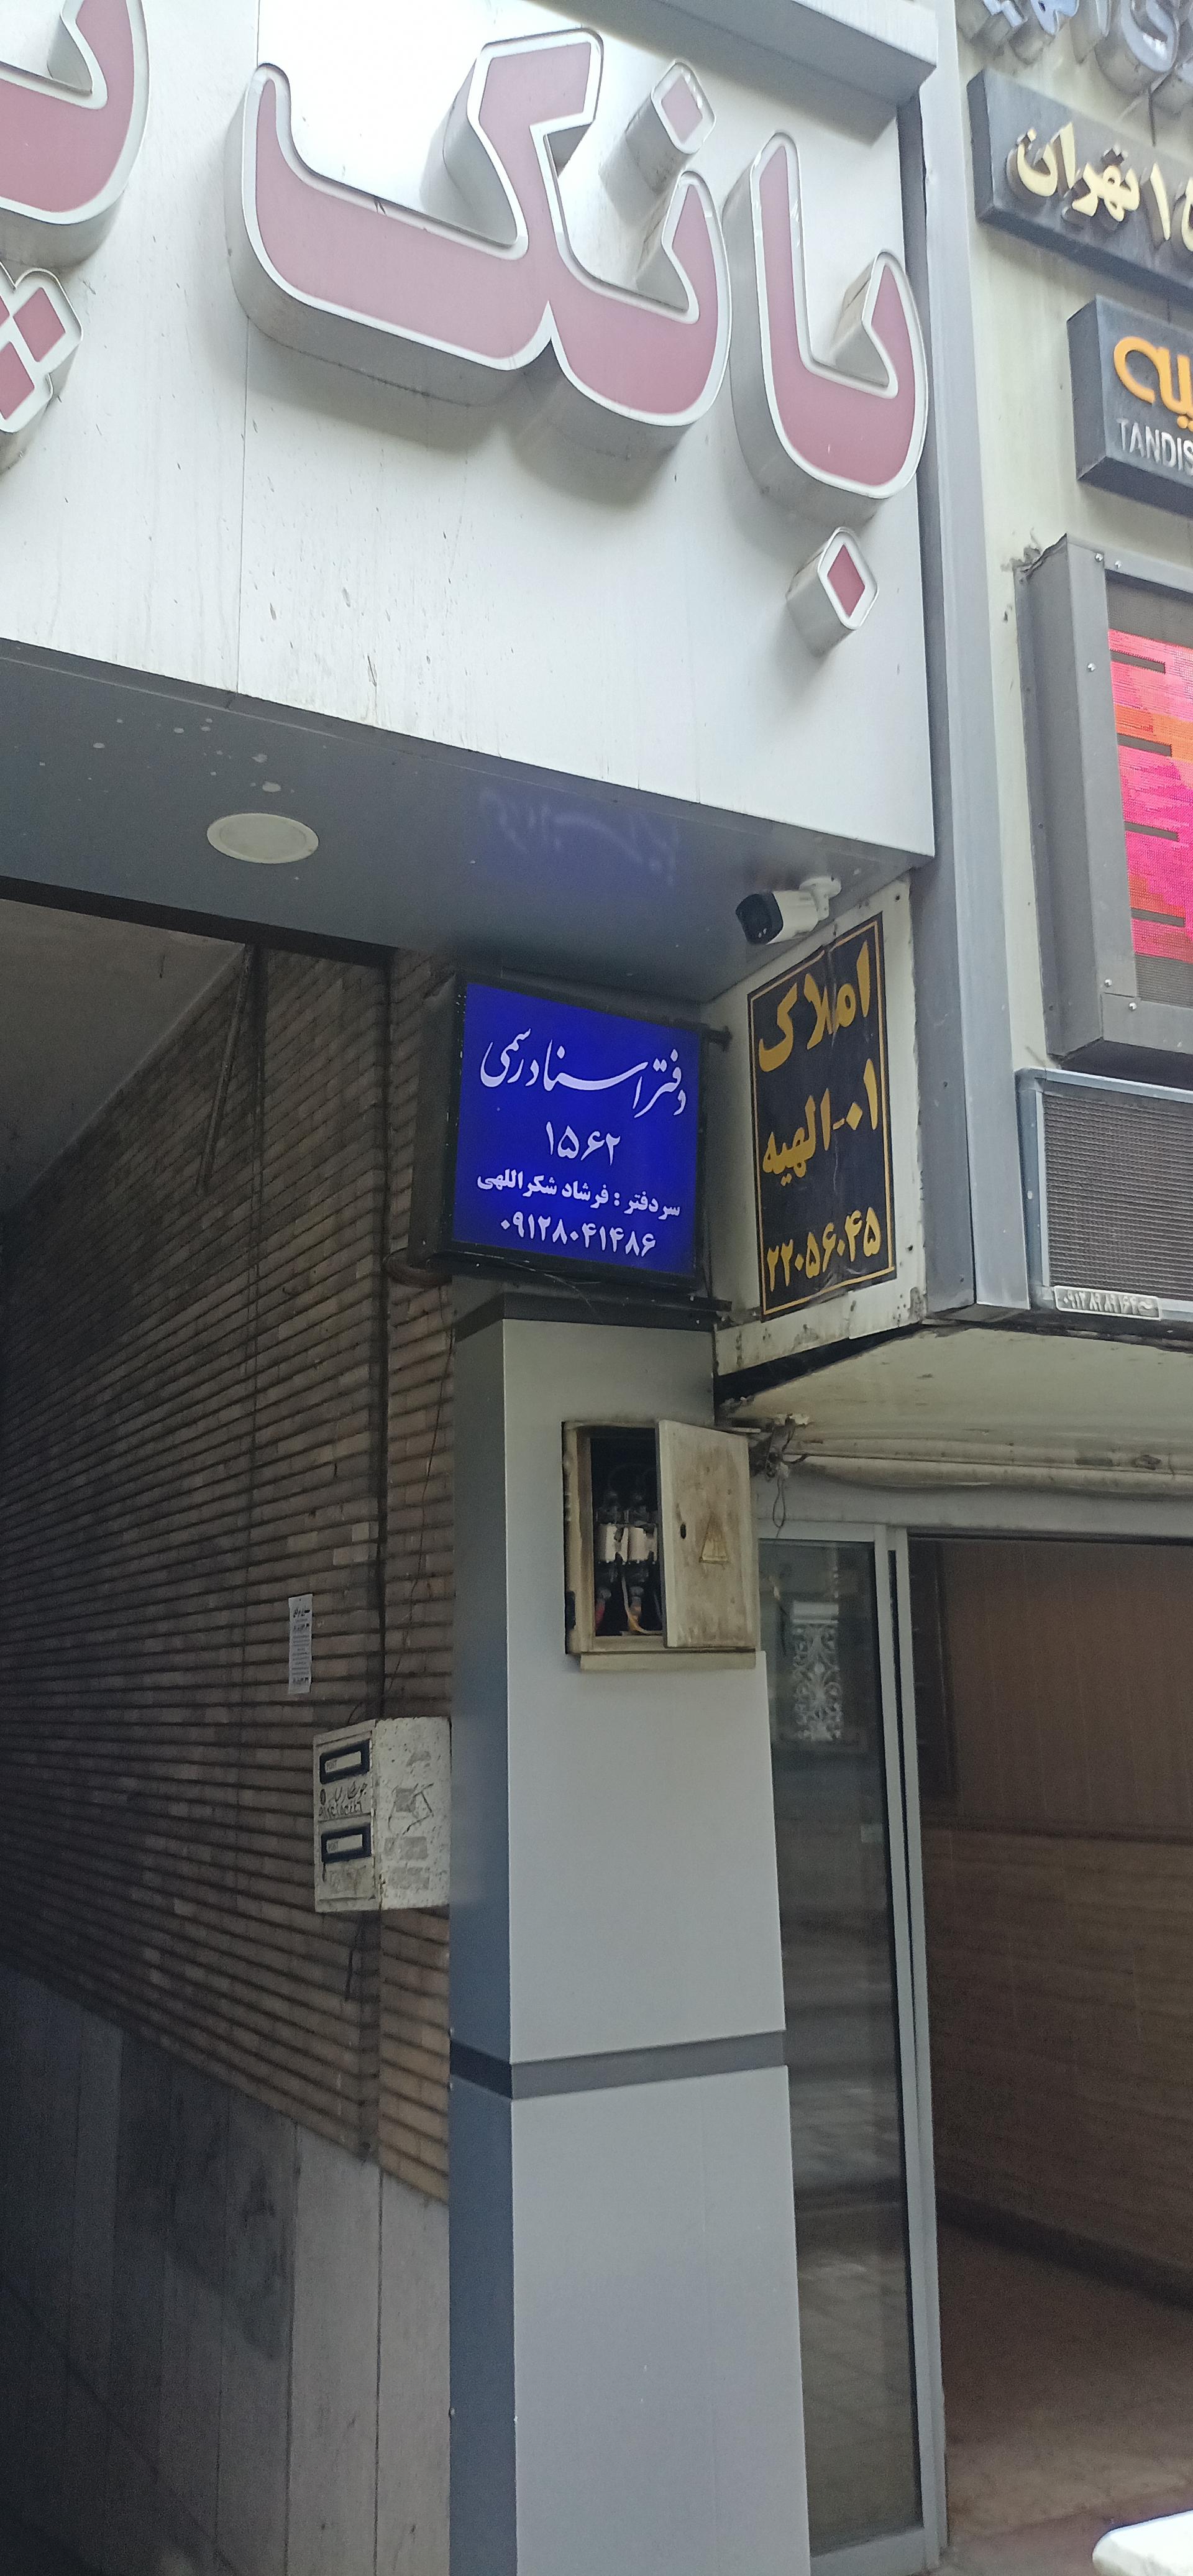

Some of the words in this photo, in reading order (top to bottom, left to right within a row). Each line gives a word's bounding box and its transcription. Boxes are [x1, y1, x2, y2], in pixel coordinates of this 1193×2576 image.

[1017, 122, 1140, 222] تهران
[239, 28, 929, 633] بانک
[1116, 418, 1193, 477] TANDIS
[758, 940, 871, 1073] املاک
[480, 1028, 532, 1088] رسمی
[525, 1038, 649, 1109] اسناد
[634, 1048, 687, 1119] دفتر
[546, 1121, 621, 1166] ۱۵۶۲
[561, 1180, 609, 1209] فرشاد
[500, 1211, 656, 1257] ۰۹۱۲۸۰۴۱۴۸۶
[767, 1206, 882, 1293] ۲۲۰۵۶۰۴۵
